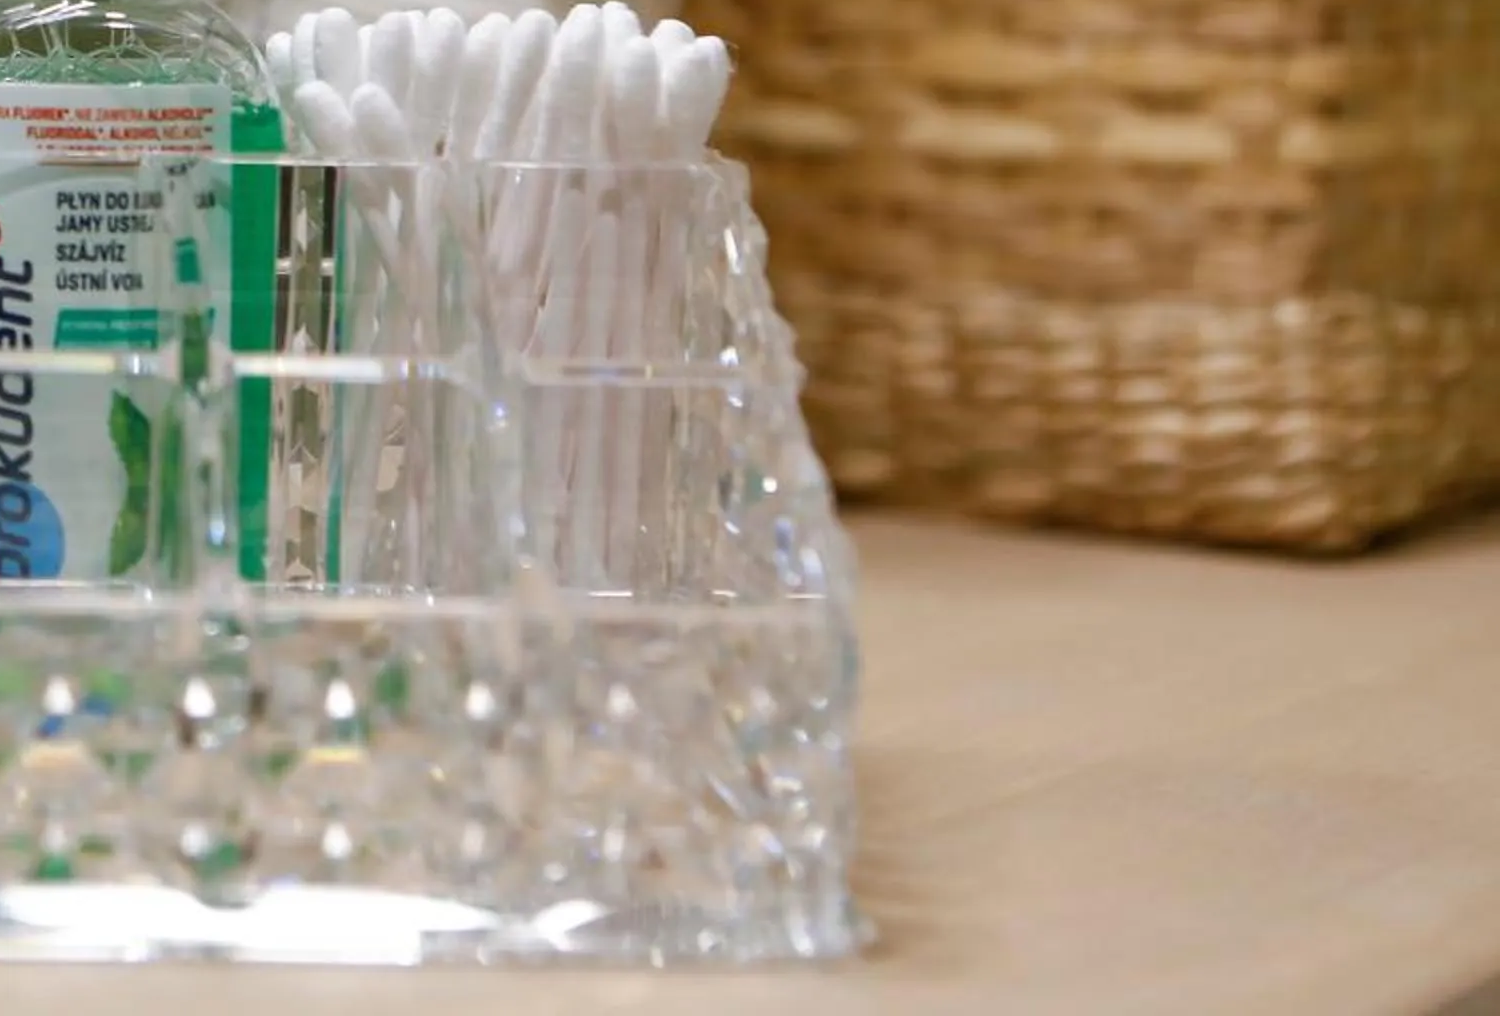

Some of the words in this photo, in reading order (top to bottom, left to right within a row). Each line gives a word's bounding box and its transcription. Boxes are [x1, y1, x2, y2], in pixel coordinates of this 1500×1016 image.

[56, 190, 100, 210] PŁYN
[105, 190, 130, 210] DO
[56, 214, 103, 233] JAMY
[56, 237, 126, 263] SZÁJVÍZ
[56, 268, 107, 292] ÚSTNÍ
